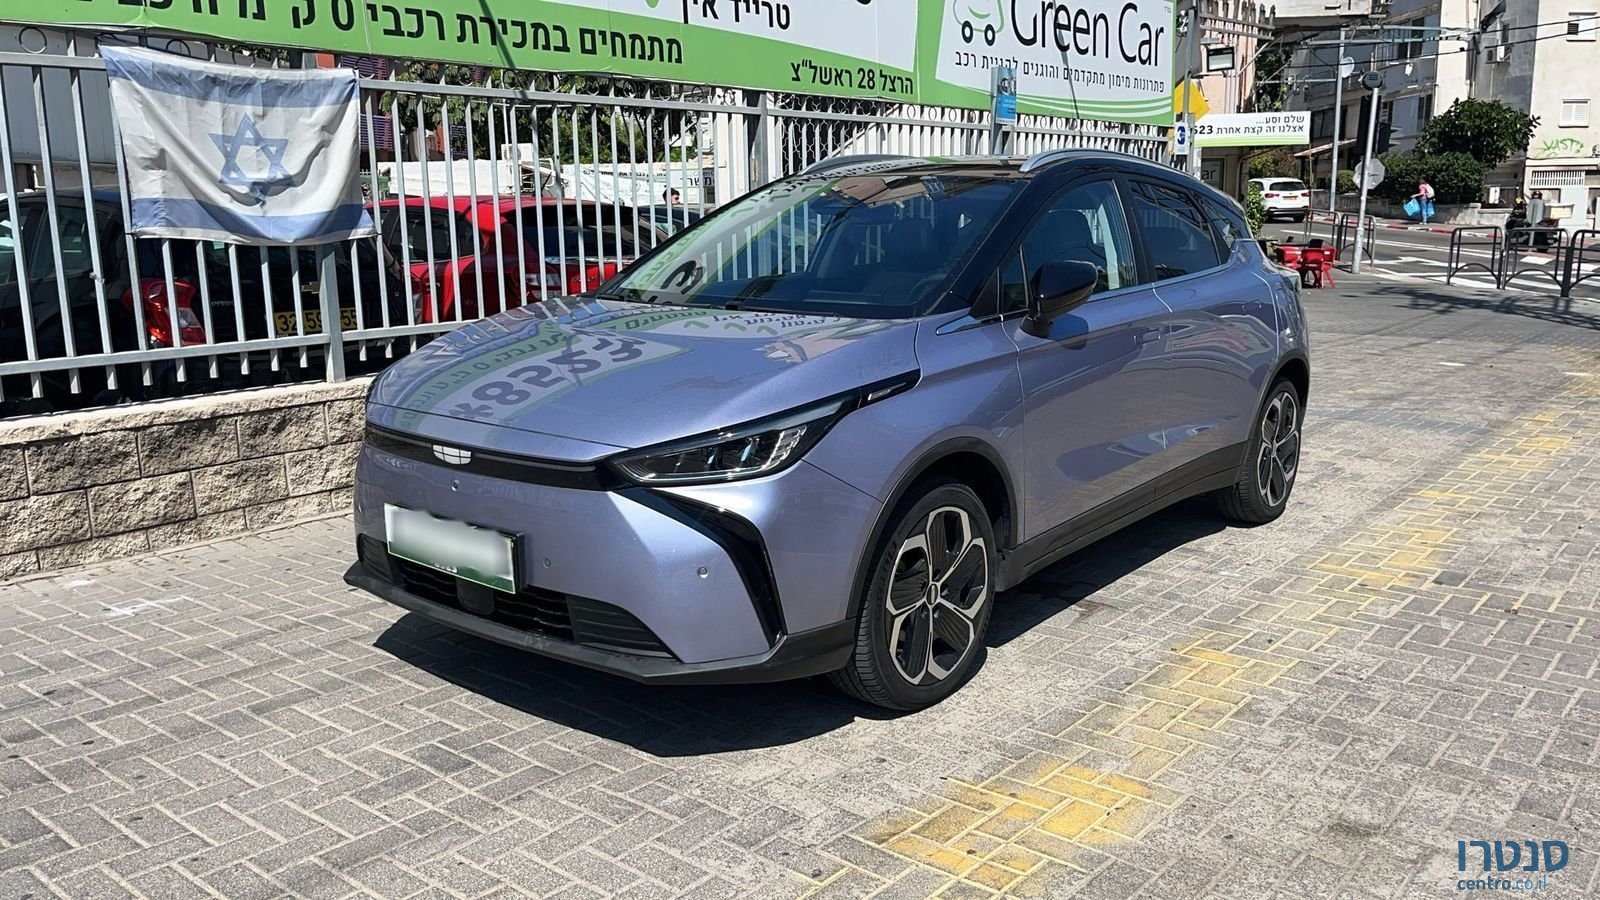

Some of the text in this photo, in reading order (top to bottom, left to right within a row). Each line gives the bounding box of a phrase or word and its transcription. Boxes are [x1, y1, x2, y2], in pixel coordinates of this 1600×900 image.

[366, 3, 446, 41] רכבי
[728, 0, 791, 30] טרייד
[456, 13, 571, 53] במכירת
[1011, 0, 1165, 67] Green Car
[578, 27, 683, 64] מתמחים
[955, 51, 977, 68] רכב
[857, 67, 876, 90] 28
[1023, 61, 1059, 79] והוגנים
[1063, 67, 1105, 87] מתקדמים
[879, 69, 914, 95] הרצל
[1108, 73, 1131, 90] מימון
[1133, 77, 1165, 93] פתרונות
[1278, 123, 1304, 133] אצלנו
[1283, 115, 1305, 124] שלם
[1216, 126, 1241, 135] אחרת
[1243, 126, 1263, 136] קצת
[1265, 125, 1275, 133] זה
